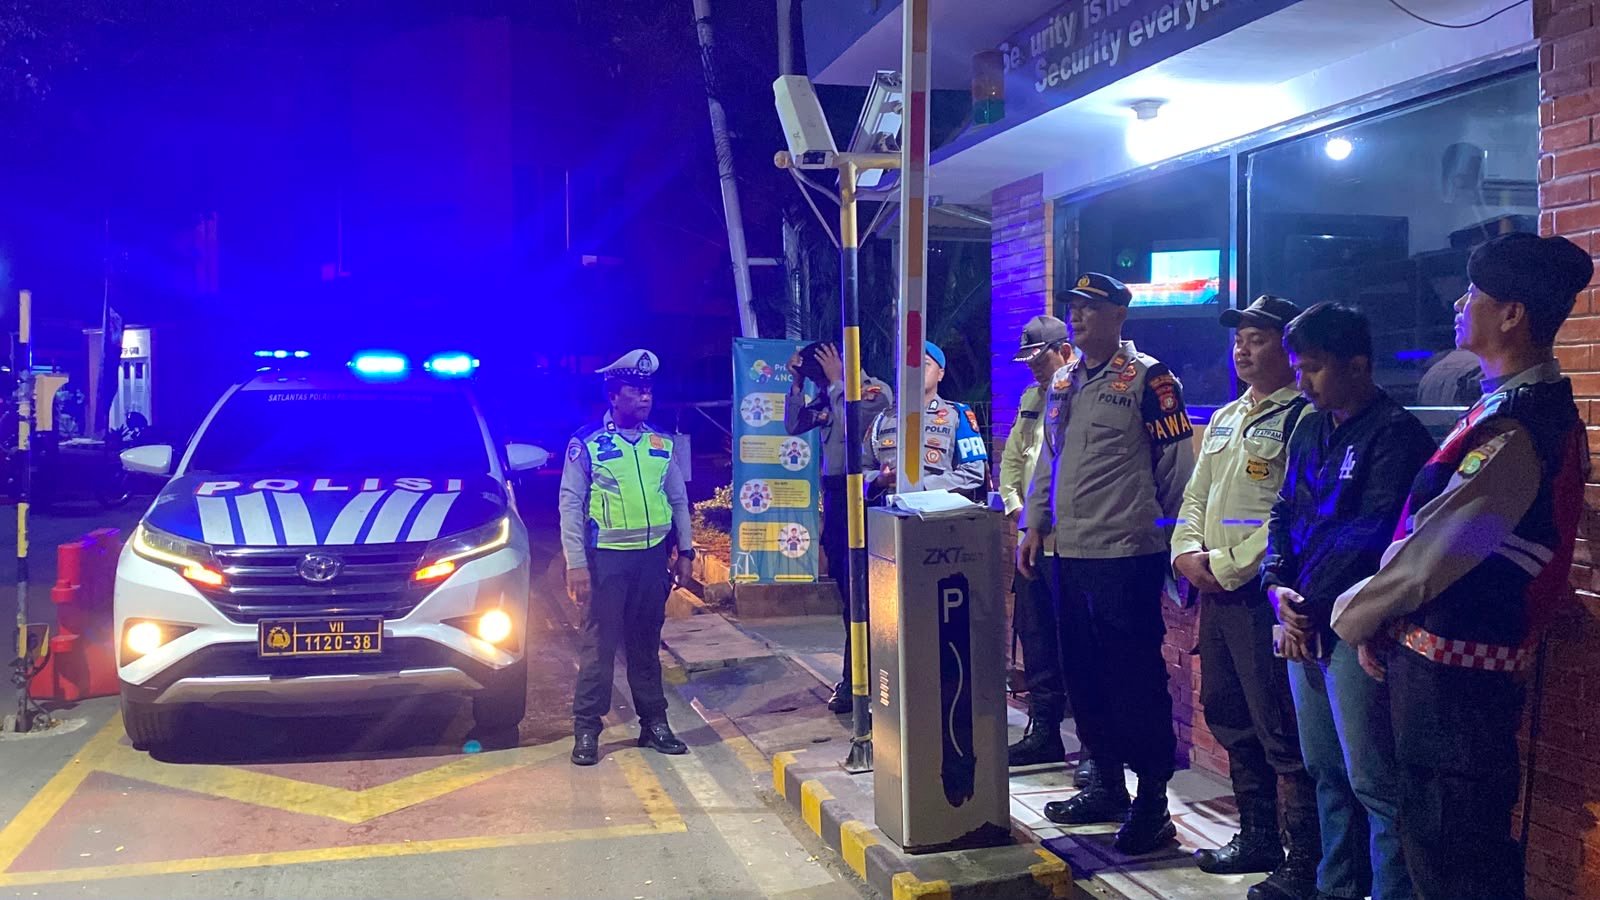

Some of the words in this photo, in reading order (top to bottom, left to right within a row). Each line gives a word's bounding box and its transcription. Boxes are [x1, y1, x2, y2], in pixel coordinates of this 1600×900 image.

[1034, 29, 1122, 93] Security
[268, 393, 308, 402] SATLANTAS
[1098, 393, 1132, 408] POLRI
[924, 425, 951, 436] POLRI
[197, 478, 463, 495] POLISI
[943, 588, 963, 623] P
[329, 621, 344, 633] VII
[305, 635, 371, 651] 1120-38
